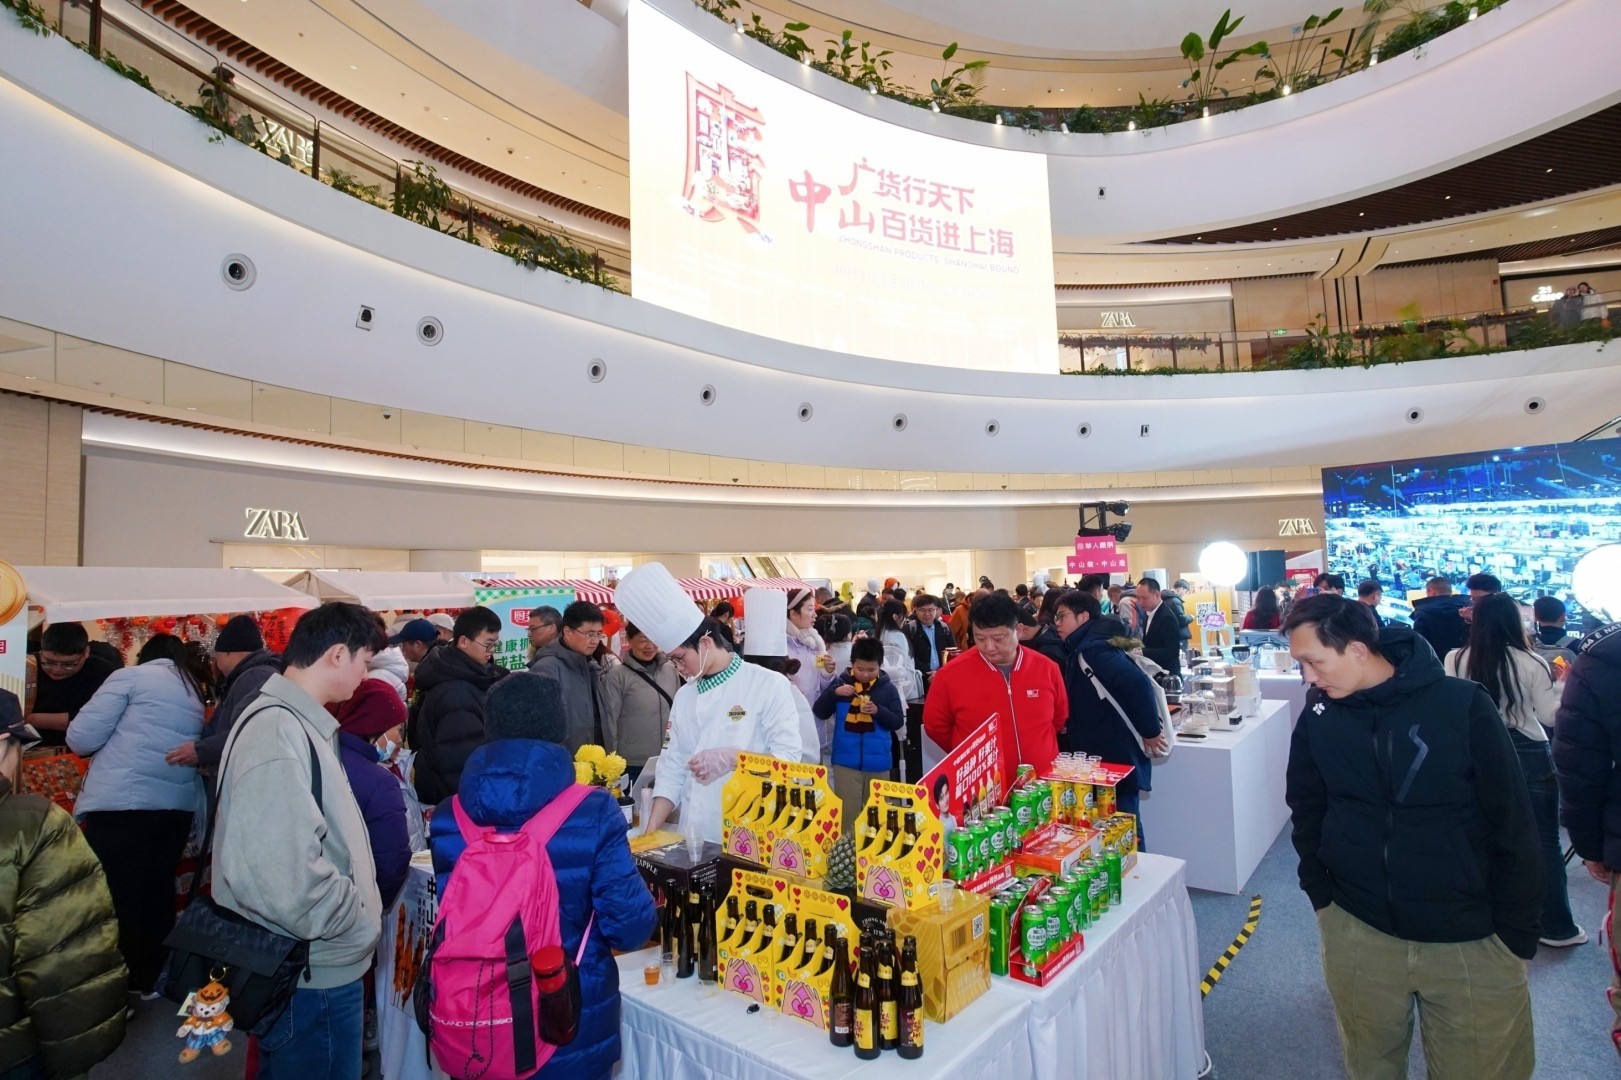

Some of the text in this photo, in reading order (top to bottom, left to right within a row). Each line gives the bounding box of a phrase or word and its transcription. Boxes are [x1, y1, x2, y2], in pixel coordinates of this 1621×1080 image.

[838, 157, 976, 215] 广货行天下
[838, 235, 892, 256] ZHONGSHAN
[944, 256, 987, 271] SHANGHAI
[989, 263, 1020, 274] BOUND
[1101, 311, 1136, 328] ZARA
[244, 507, 309, 541] ZARA
[1278, 518, 1317, 536] ZARA
